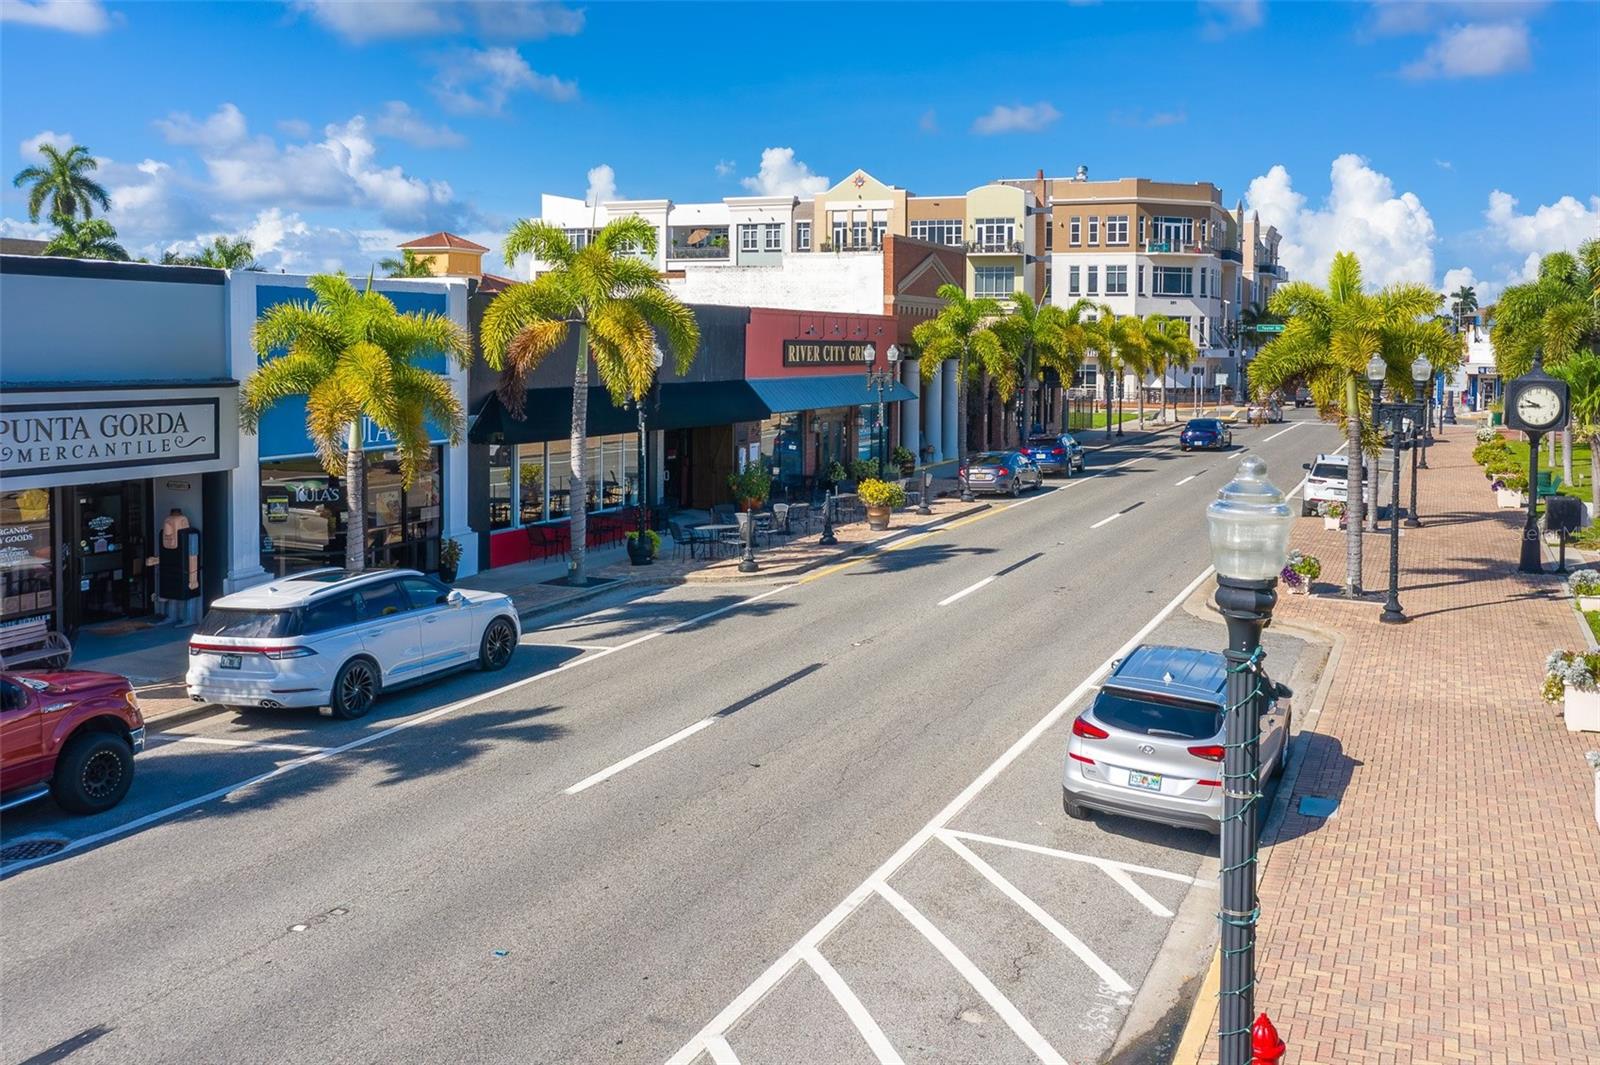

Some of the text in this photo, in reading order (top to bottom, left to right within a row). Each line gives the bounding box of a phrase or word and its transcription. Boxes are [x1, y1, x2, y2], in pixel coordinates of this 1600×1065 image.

[788, 345, 866, 362] RIVER CITY GRI
[0, 411, 190, 444] PUNTA GORDA
[17, 438, 172, 464] MERCANTILE
[0, 525, 29, 536] RGANIC
[5, 534, 33, 543] GOODS
